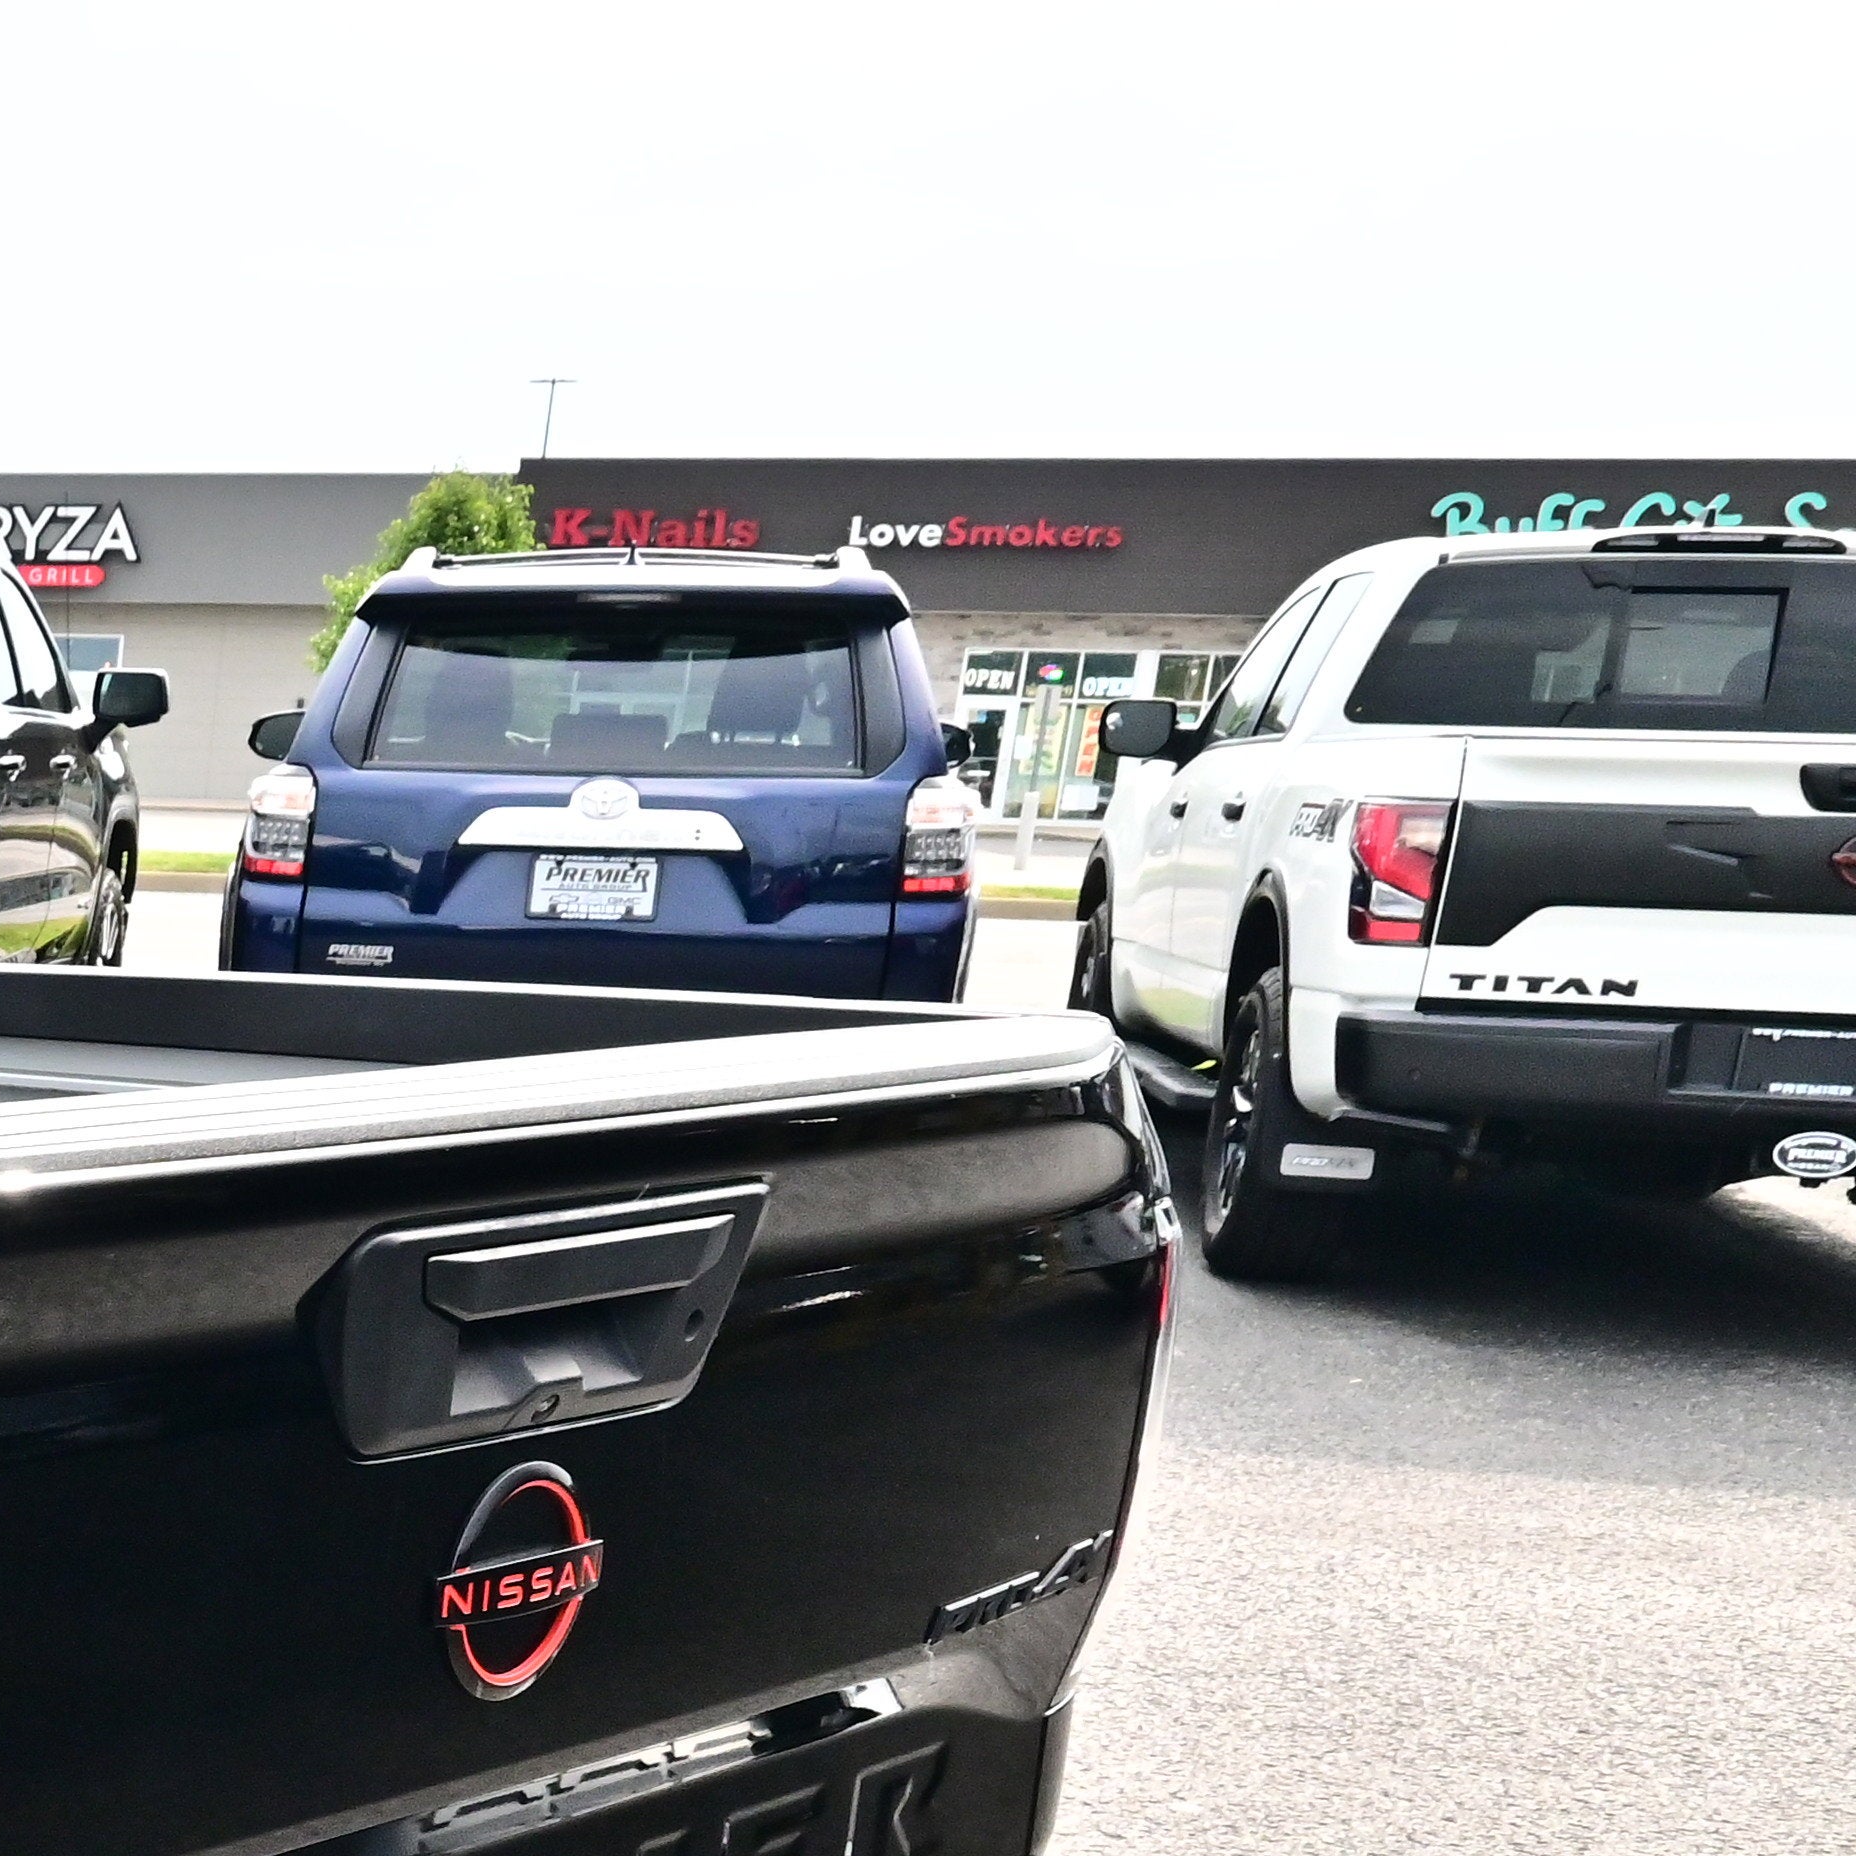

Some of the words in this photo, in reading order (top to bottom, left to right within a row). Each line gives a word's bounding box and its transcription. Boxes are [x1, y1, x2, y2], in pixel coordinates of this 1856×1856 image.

[548, 508, 760, 547] K-Nails
[28, 568, 94, 585] GRILL
[965, 668, 1015, 690] OPEN
[545, 867, 650, 892] PREMIER
[328, 944, 394, 963] PREMIER
[1449, 973, 1638, 997] TITAN
[440, 1553, 599, 1619] NISSAN
